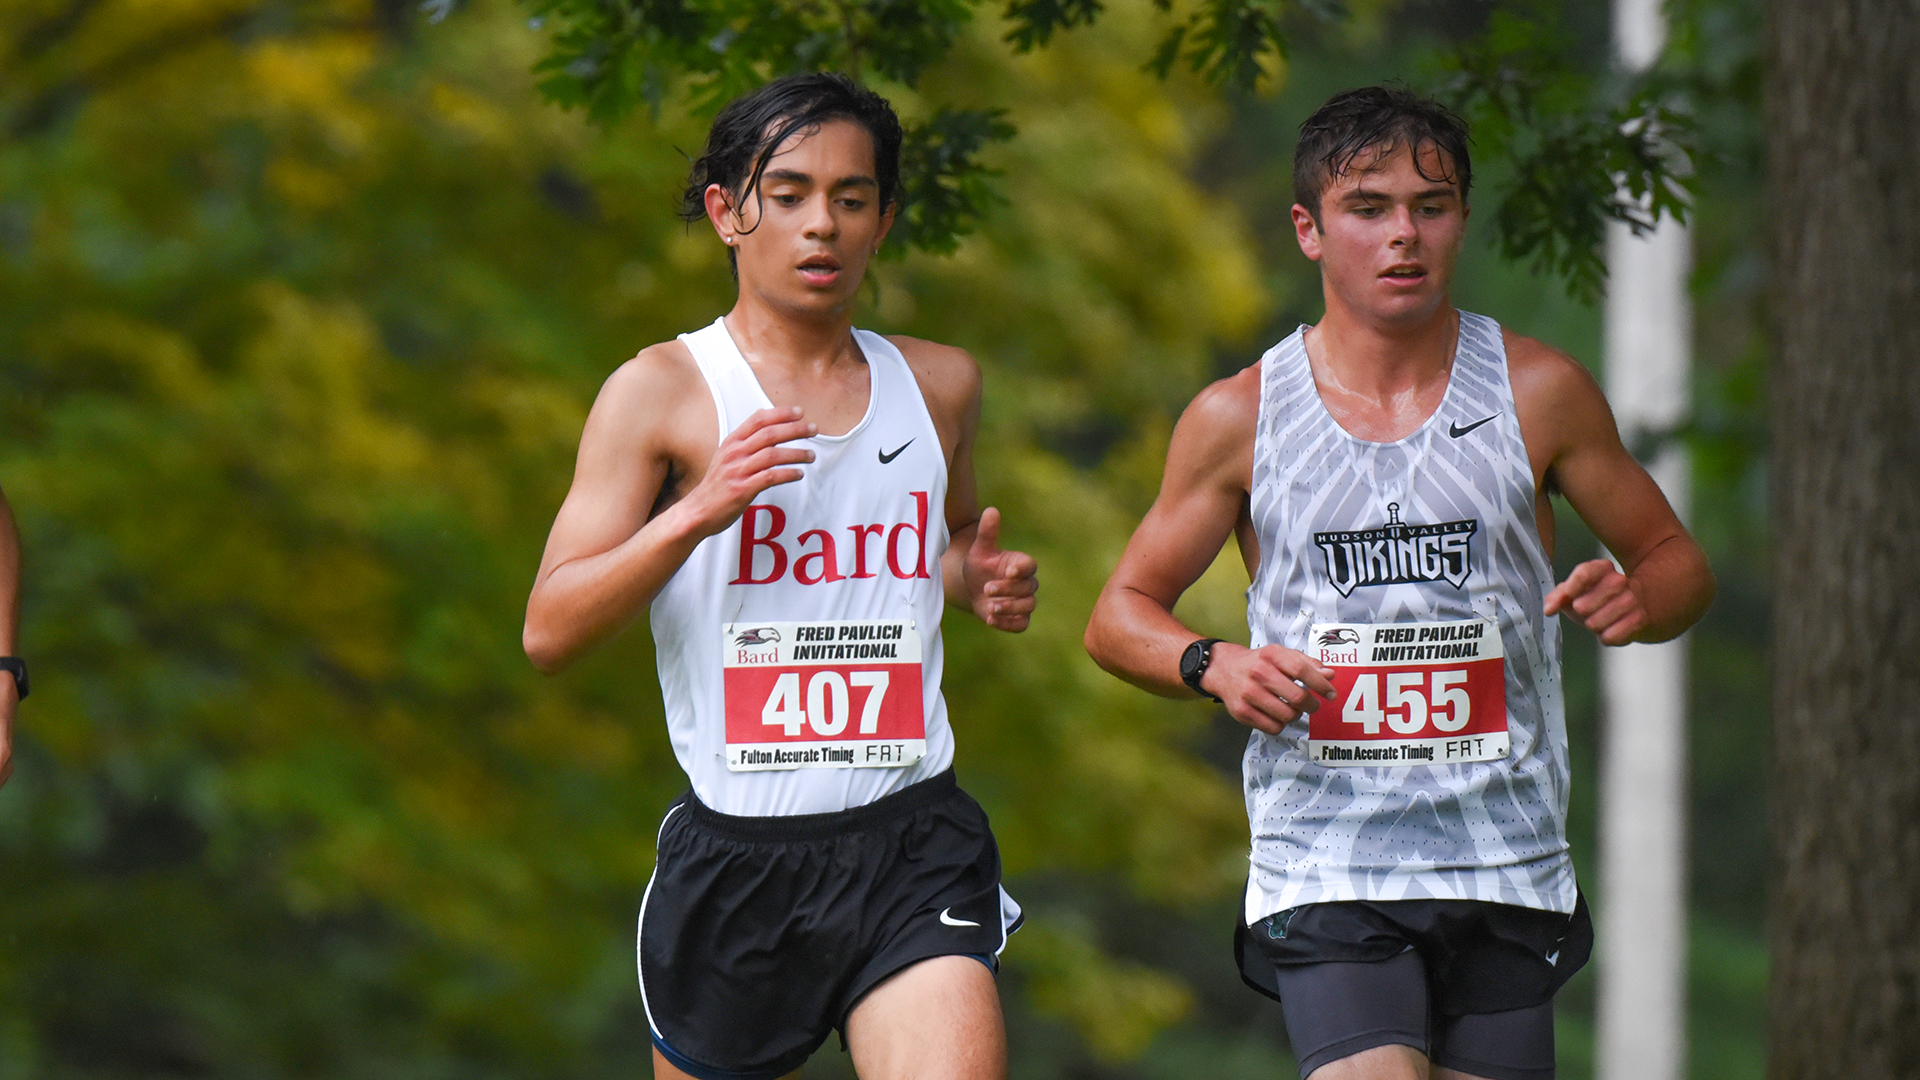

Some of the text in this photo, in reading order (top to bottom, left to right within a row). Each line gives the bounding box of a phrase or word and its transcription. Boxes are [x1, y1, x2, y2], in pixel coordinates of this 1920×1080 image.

[729, 491, 930, 585] Bard
[1318, 522, 1474, 542] HUDSON VALLEY
[1320, 531, 1472, 598] VIKINGS
[795, 625, 903, 641] FRED PAVLICH
[1374, 623, 1484, 643] FRED PAVLICH
[737, 647, 779, 664] Bard
[793, 643, 898, 660] INVITATIONAL
[1320, 648, 1358, 664] Bard
[1371, 642, 1479, 661] INVITATIONAL
[761, 670, 890, 736] 407
[1342, 670, 1471, 735] 455
[740, 744, 905, 764] Fulton Accurate Timing FAT
[1322, 738, 1485, 761] Fulton Accurate Timing FAT
